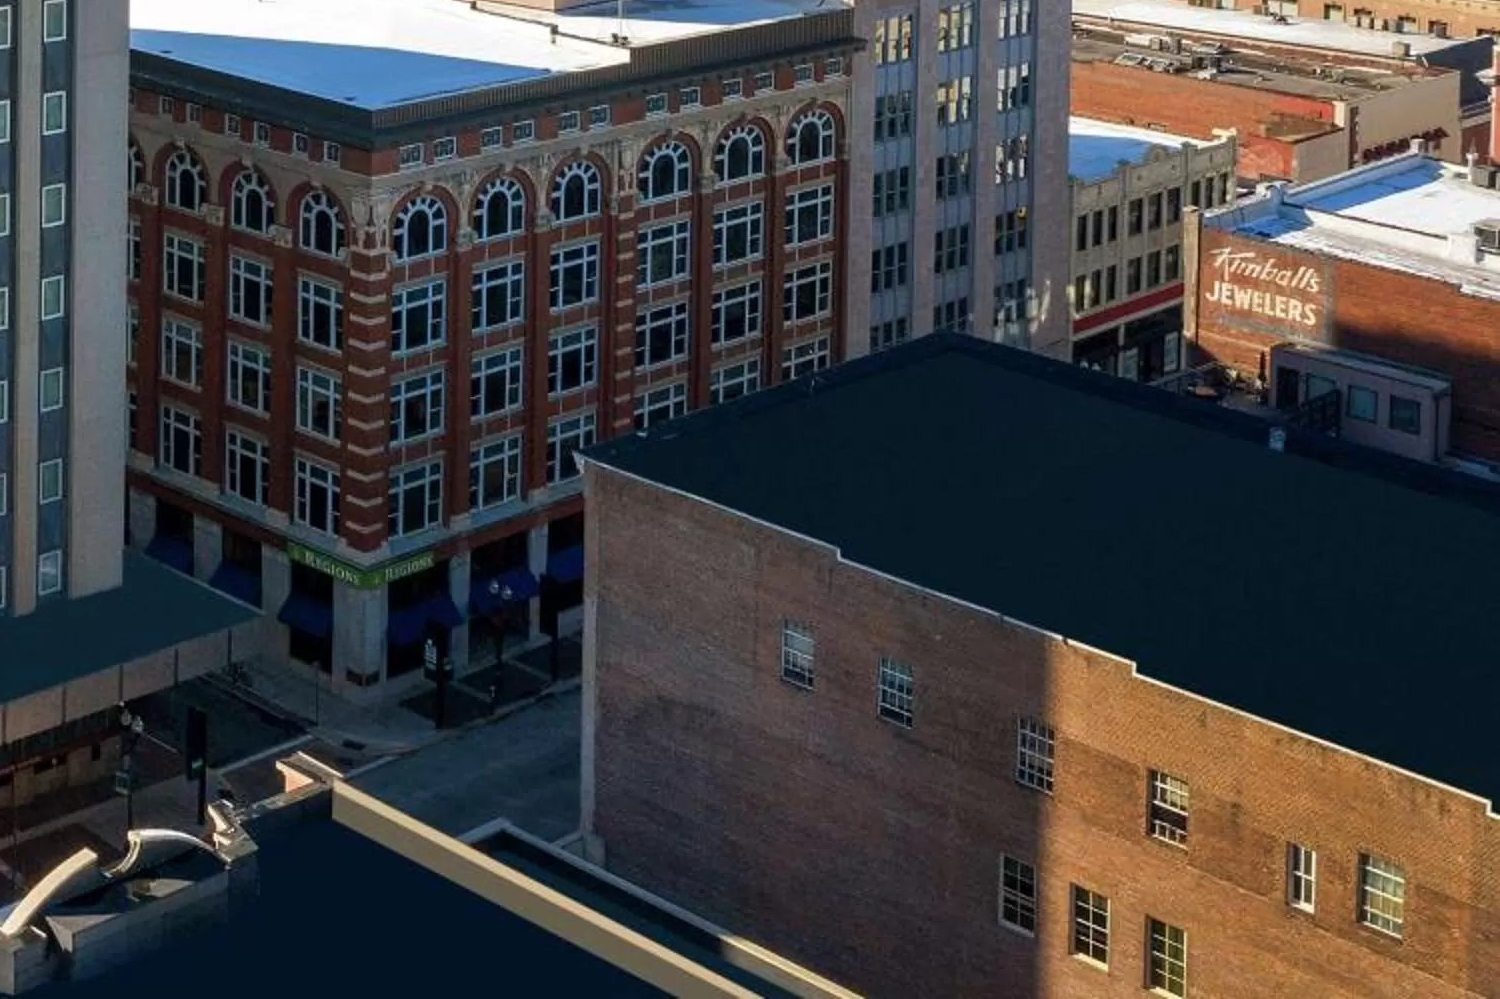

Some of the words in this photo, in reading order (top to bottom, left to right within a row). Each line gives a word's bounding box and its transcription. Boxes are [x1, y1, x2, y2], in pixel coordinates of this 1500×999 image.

[1205, 281, 1317, 326] JEWELERS
[305, 552, 360, 585] REGIONS
[385, 555, 433, 581] REGIONS
